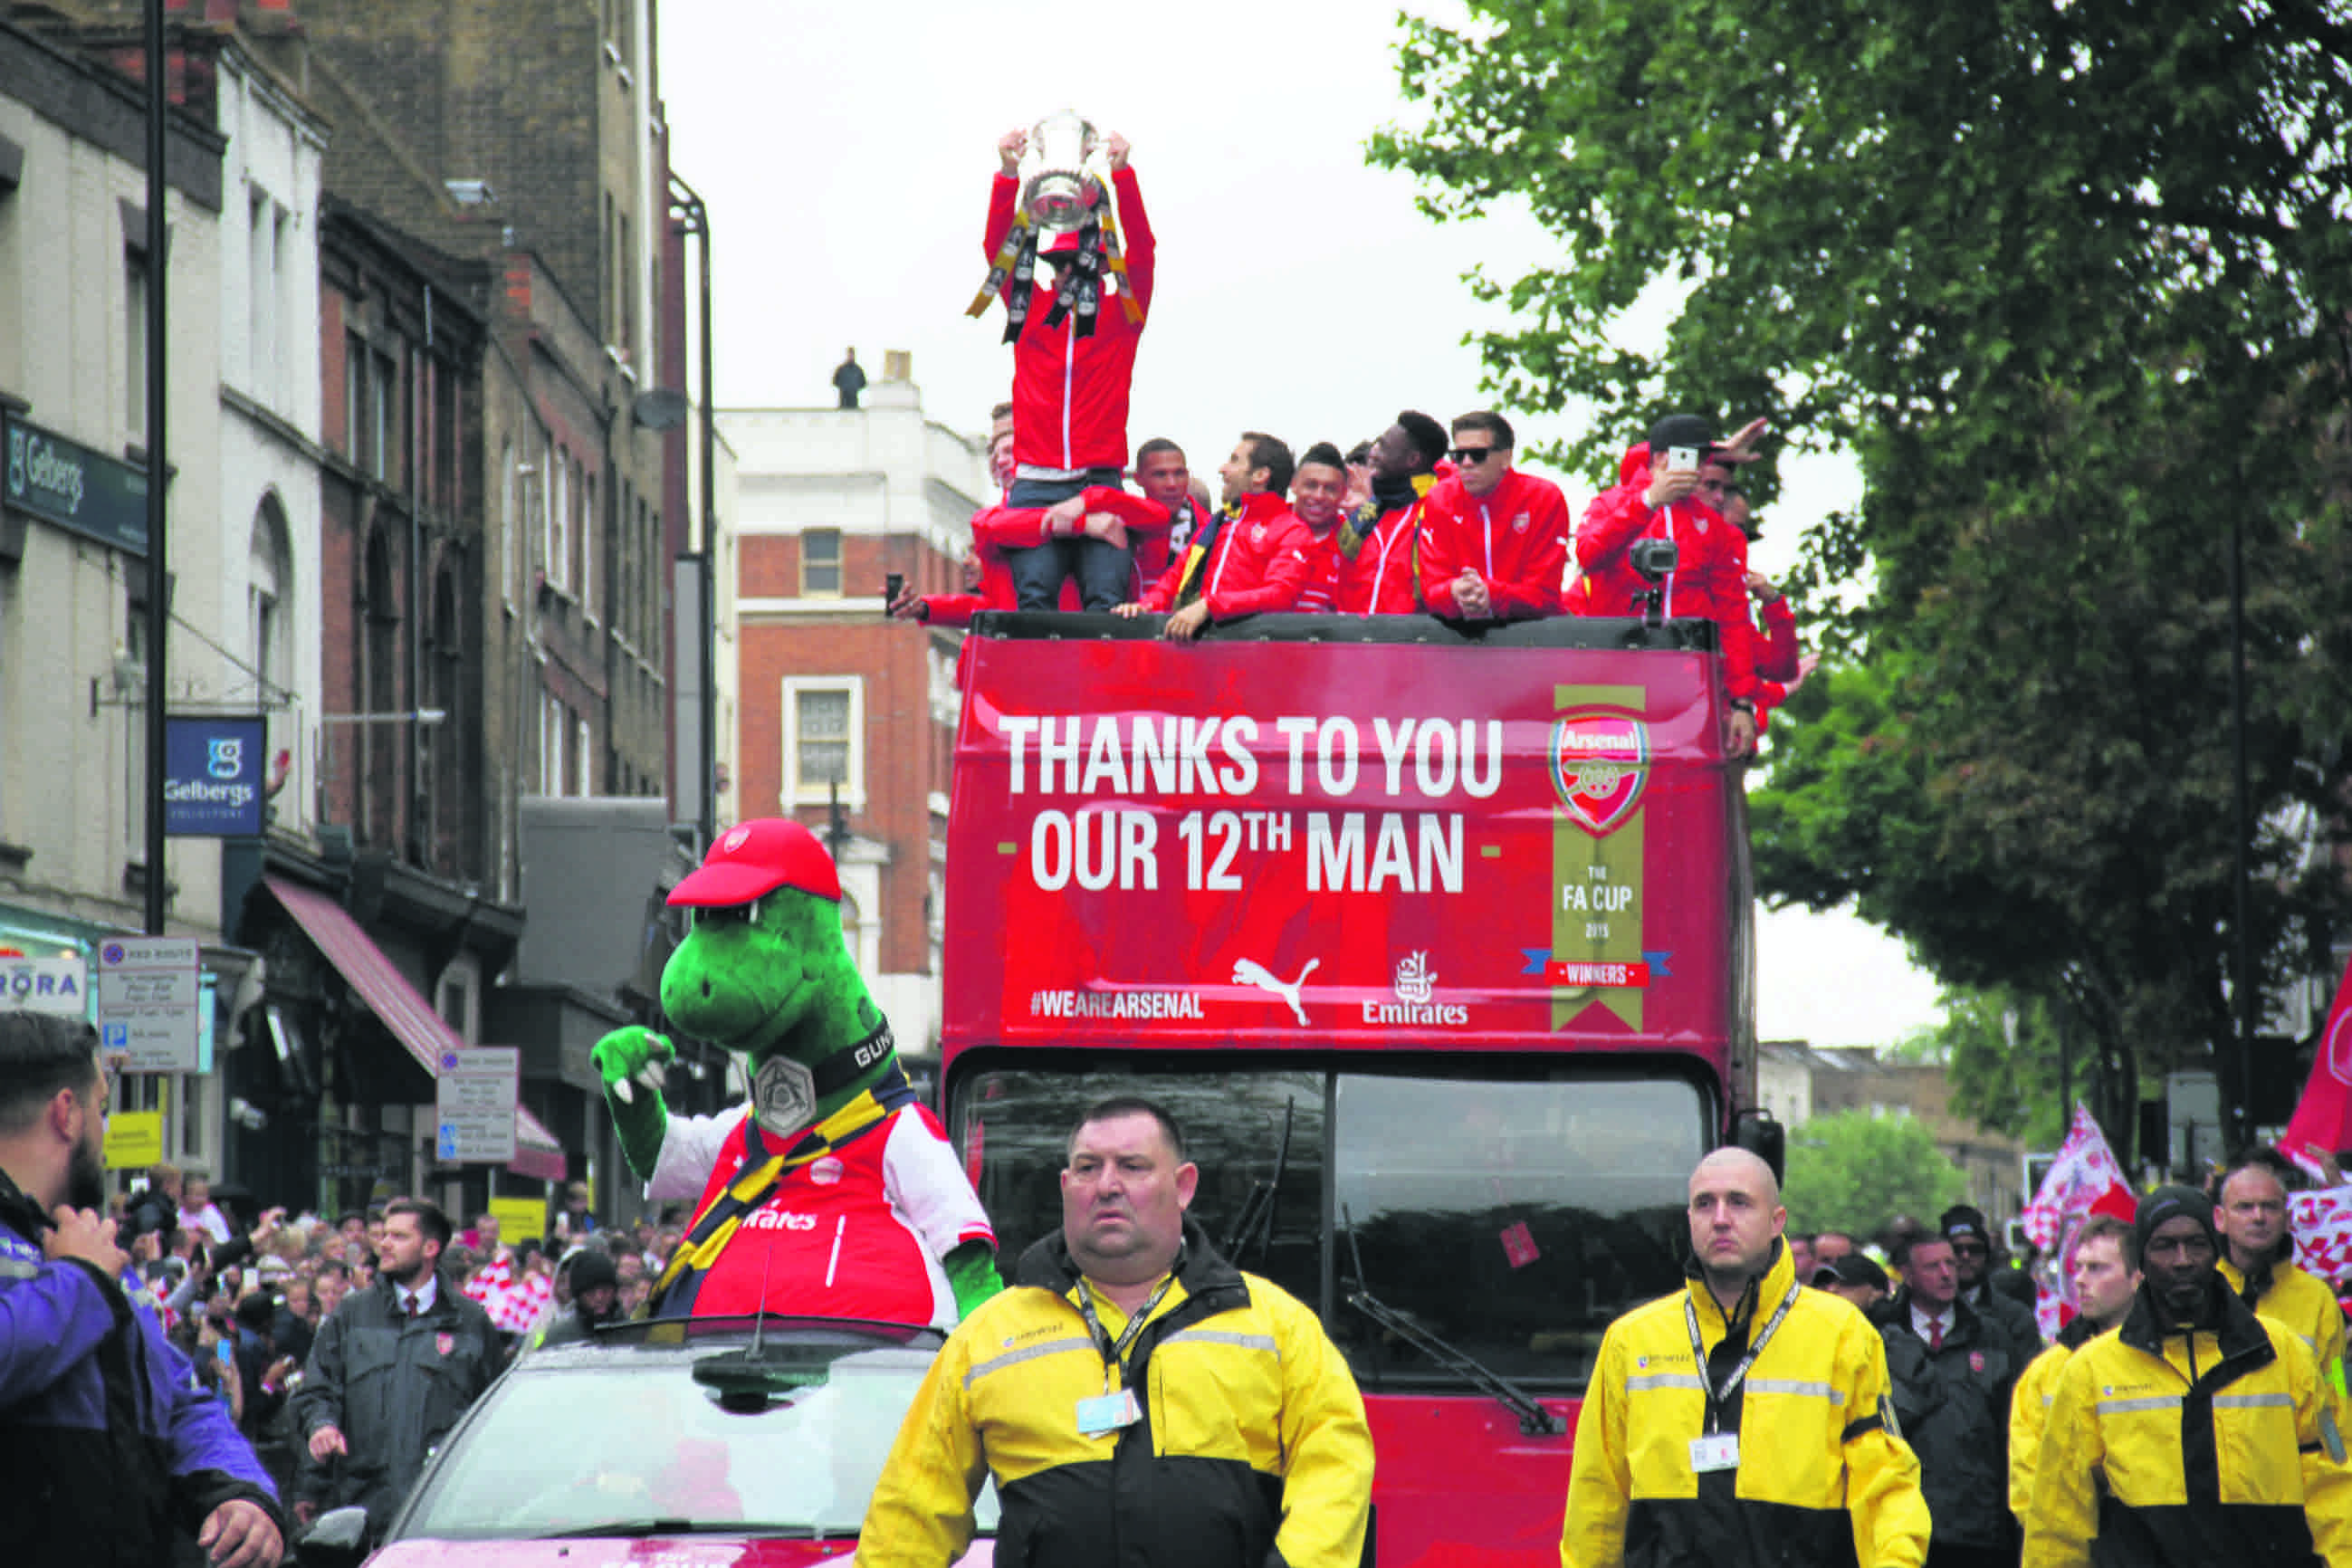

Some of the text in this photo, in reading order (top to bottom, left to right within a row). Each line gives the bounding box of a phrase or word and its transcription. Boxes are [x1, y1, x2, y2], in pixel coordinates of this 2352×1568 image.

[1563, 731, 1635, 750] Arsenal
[999, 716, 1502, 797] THANKS TO YOU
[164, 779, 253, 807] Gelbergs
[1031, 809, 1463, 893] OUR 12TH MAN
[1563, 884, 1632, 911] FA CUP
[1585, 923, 1609, 938] 2015
[1566, 962, 1627, 984] WINNERS
[1030, 990, 1204, 1018] #WEAREARSENAL
[1362, 999, 1468, 1024] Emirates
